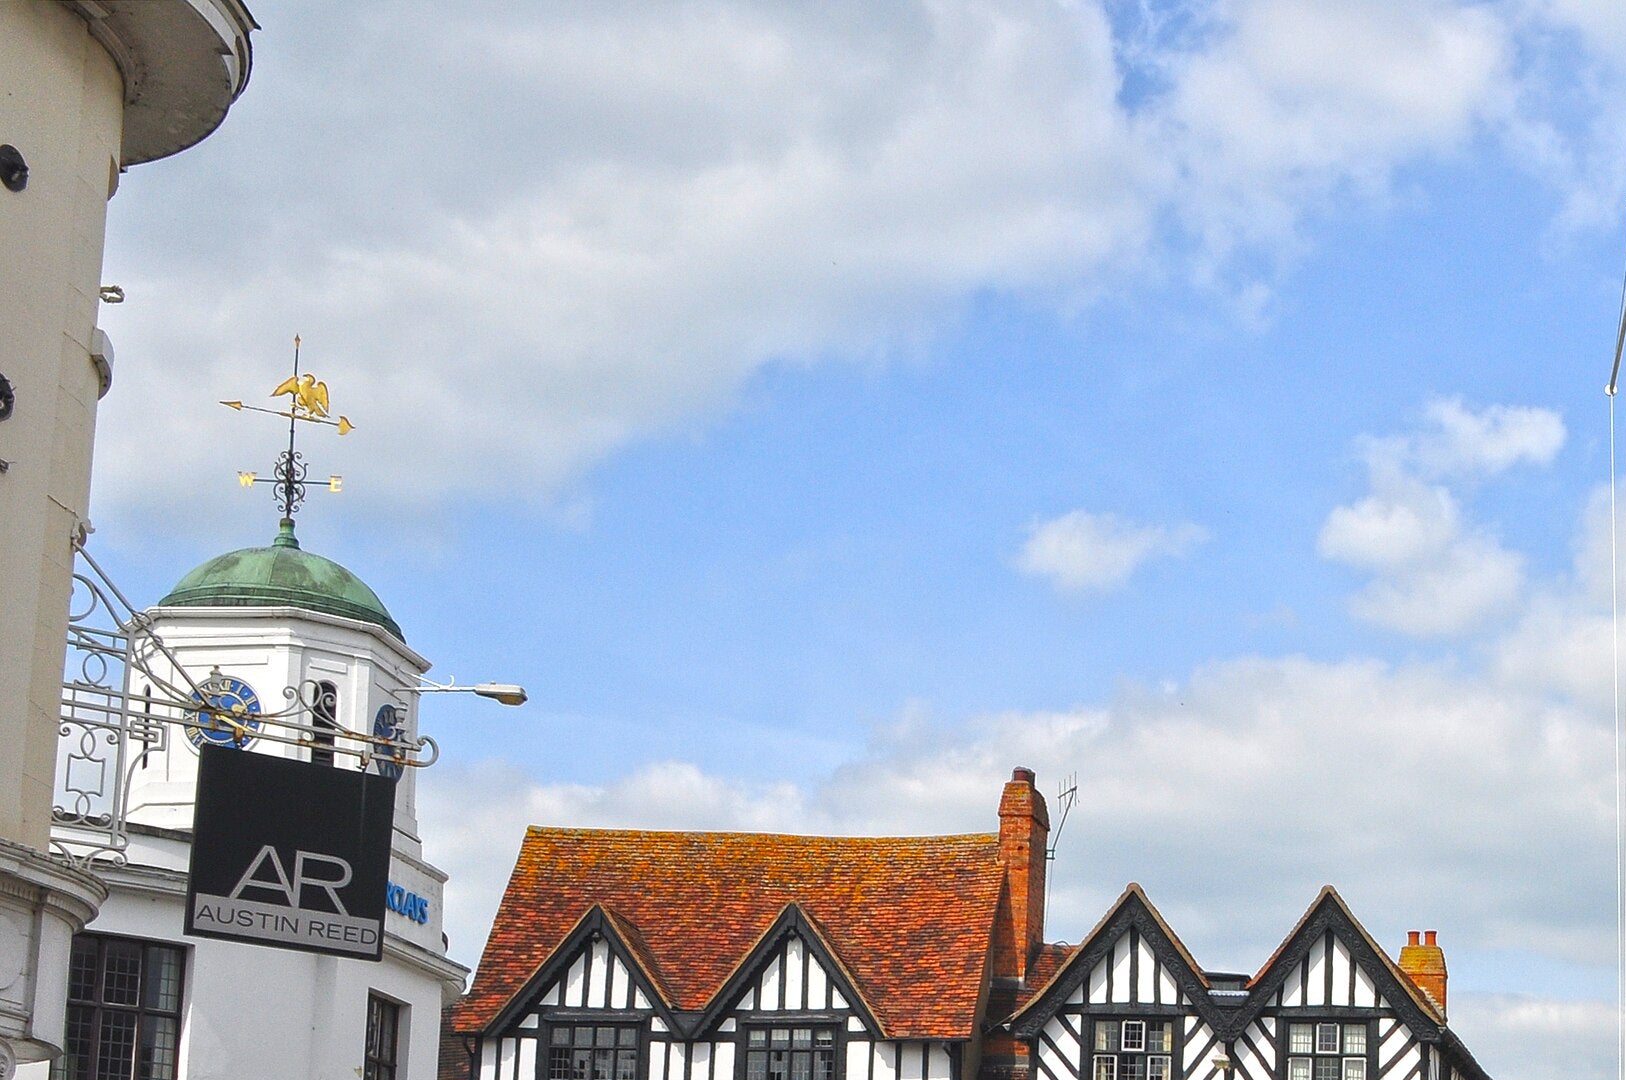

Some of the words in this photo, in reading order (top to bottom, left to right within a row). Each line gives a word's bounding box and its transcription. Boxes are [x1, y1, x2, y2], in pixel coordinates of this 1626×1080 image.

[228, 845, 353, 916] AR
[386, 880, 429, 925] RCLAYS
[196, 904, 299, 934] AUSTIN
[308, 920, 378, 945] REED
